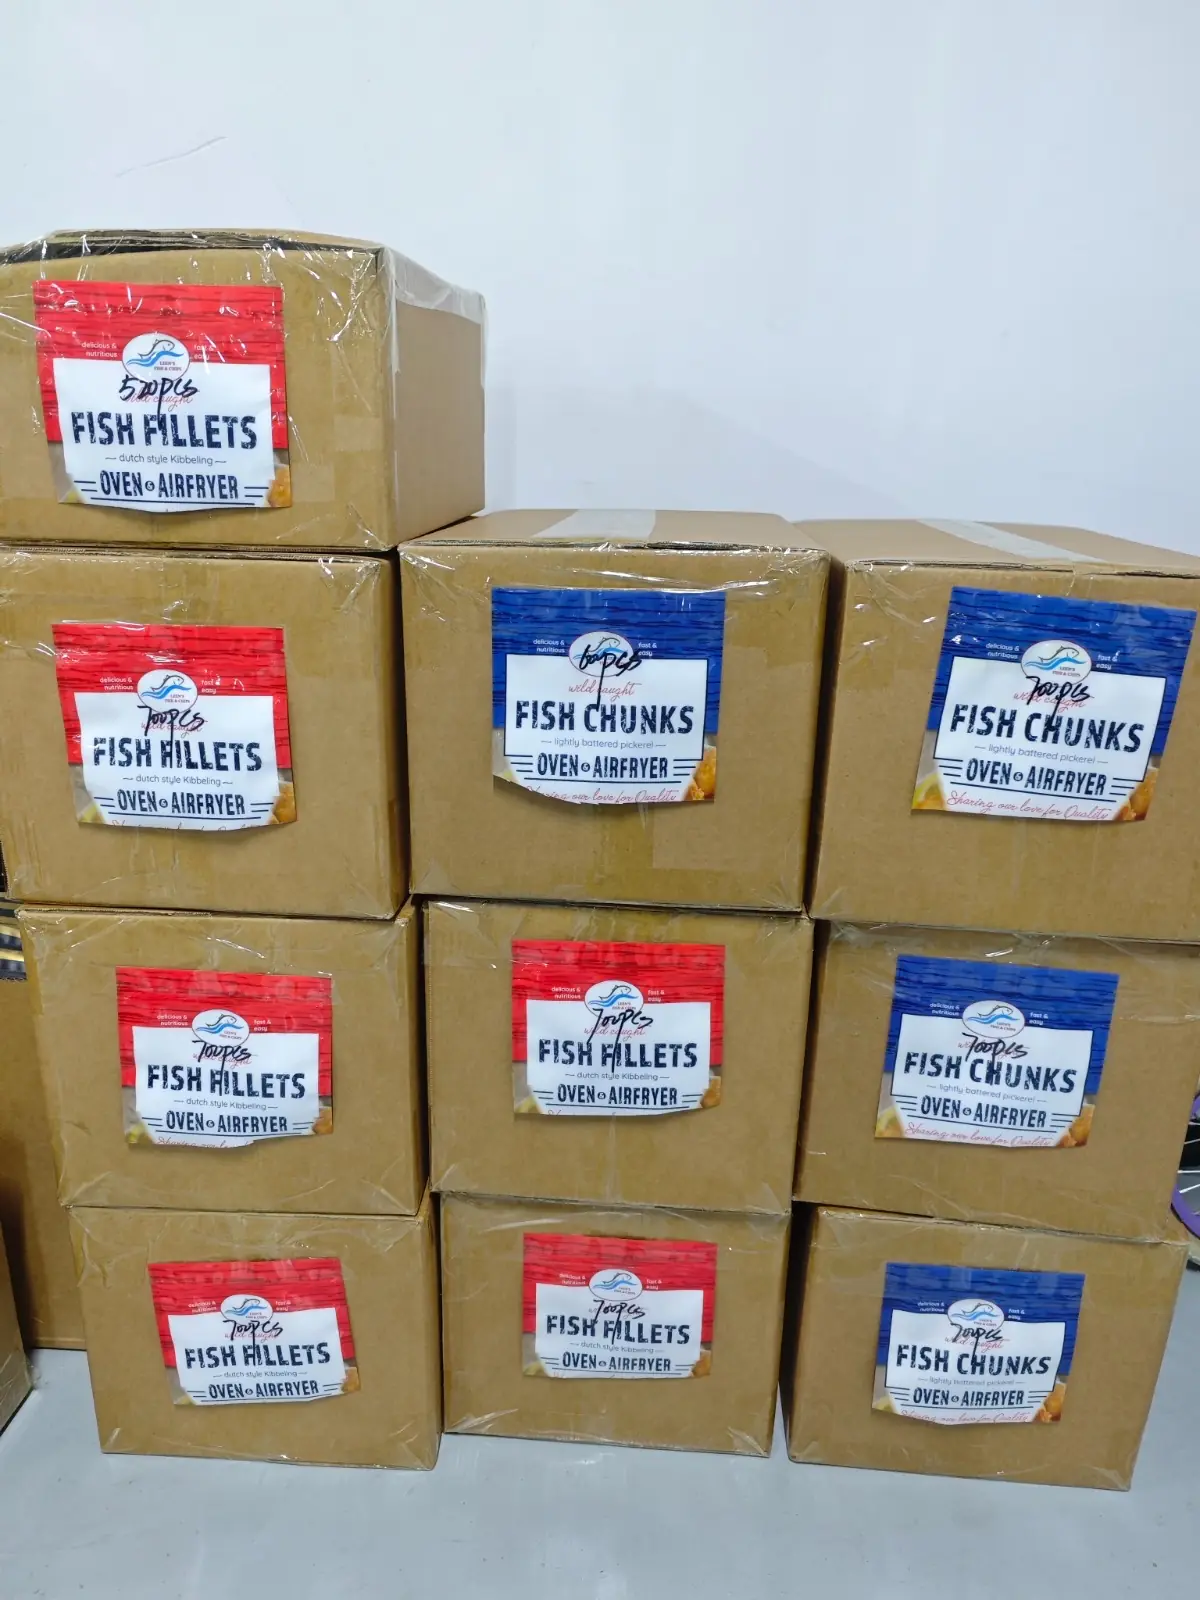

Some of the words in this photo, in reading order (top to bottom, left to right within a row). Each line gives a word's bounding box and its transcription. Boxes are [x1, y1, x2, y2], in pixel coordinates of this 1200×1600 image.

[71, 412, 135, 445] FISH
[143, 413, 257, 450] FILLETS
[119, 454, 144, 463] dutch
[147, 455, 168, 464] style
[170, 455, 213, 466] Kibbeling
[100, 470, 143, 496] OVEN
[158, 473, 239, 499] AIRFRYER
[985, 642, 1012, 651] delicious
[988, 651, 1018, 660] nutritious
[1098, 654, 1111, 662] fast
[568, 679, 594, 694] wild
[516, 700, 575, 730] FISH
[584, 703, 694, 734] CHUNKS
[950, 704, 1017, 739] FISH
[1024, 712, 1144, 753] CHUNKS
[93, 737, 152, 767] FISH
[161, 740, 262, 771] FILLETS
[554, 738, 580, 748] lightly
[581, 738, 618, 748] battered
[620, 741, 654, 750] pickerel
[988, 744, 1016, 756] lightly
[1018, 747, 1058, 761] battered
[1060, 753, 1096, 765] pickerel
[537, 753, 578, 777] OVEN
[593, 756, 668, 778] AIRFRYER
[136, 775, 159, 783] dutch
[162, 776, 180, 785] style
[183, 776, 221, 787] Kibbeling
[966, 758, 1012, 785] OVEN
[1024, 766, 1107, 796] AIRFRYER
[117, 789, 157, 812] OVEN
[172, 791, 245, 815] AIRFRYER
[946, 791, 998, 814] Sharing
[999, 803, 1018, 811] our
[1020, 799, 1042, 813] love
[1042, 800, 1062, 818] for
[1064, 804, 1112, 820] Quality
[539, 1039, 592, 1066] FISH
[601, 1042, 697, 1068] FILLETS
[147, 1065, 202, 1092] FISH
[210, 1069, 305, 1098] FILLETS
[601, 1072, 620, 1081] style
[621, 1072, 659, 1082] Kibbeling
[904, 1052, 962, 1080] FISH
[969, 1058, 1077, 1093] CHUNKS
[187, 1097, 208, 1106] dutch
[210, 1099, 228, 1108] style
[230, 1102, 266, 1111] Kibbeling
[558, 1084, 595, 1103] OVEN
[608, 1086, 677, 1106] AIRFRYER
[939, 1084, 963, 1094] lightly
[965, 1086, 1001, 1098] battered
[1003, 1092, 1035, 1103] pickerel
[166, 1111, 204, 1131] OVEN
[217, 1115, 288, 1133] AIRFRYER
[921, 1095, 960, 1119] OVEN
[973, 1103, 1046, 1128] AIRFRYER
[547, 1315, 596, 1337] FISH
[603, 1320, 690, 1344] FILLETS
[185, 1345, 236, 1369] FISH
[243, 1342, 330, 1367] FILLETS
[581, 1341, 600, 1349] dutch
[602, 1344, 619, 1352] style
[563, 1351, 597, 1369] OVEN
[609, 1356, 671, 1371] AIRFRYER
[896, 1344, 948, 1373] FISH
[957, 1353, 1051, 1376] CHUNKS
[209, 1384, 244, 1399] OVEN
[256, 1380, 319, 1397] AIRFRYER
[914, 1388, 949, 1404] OVEN
[961, 1390, 1025, 1407] AIRFRYER
